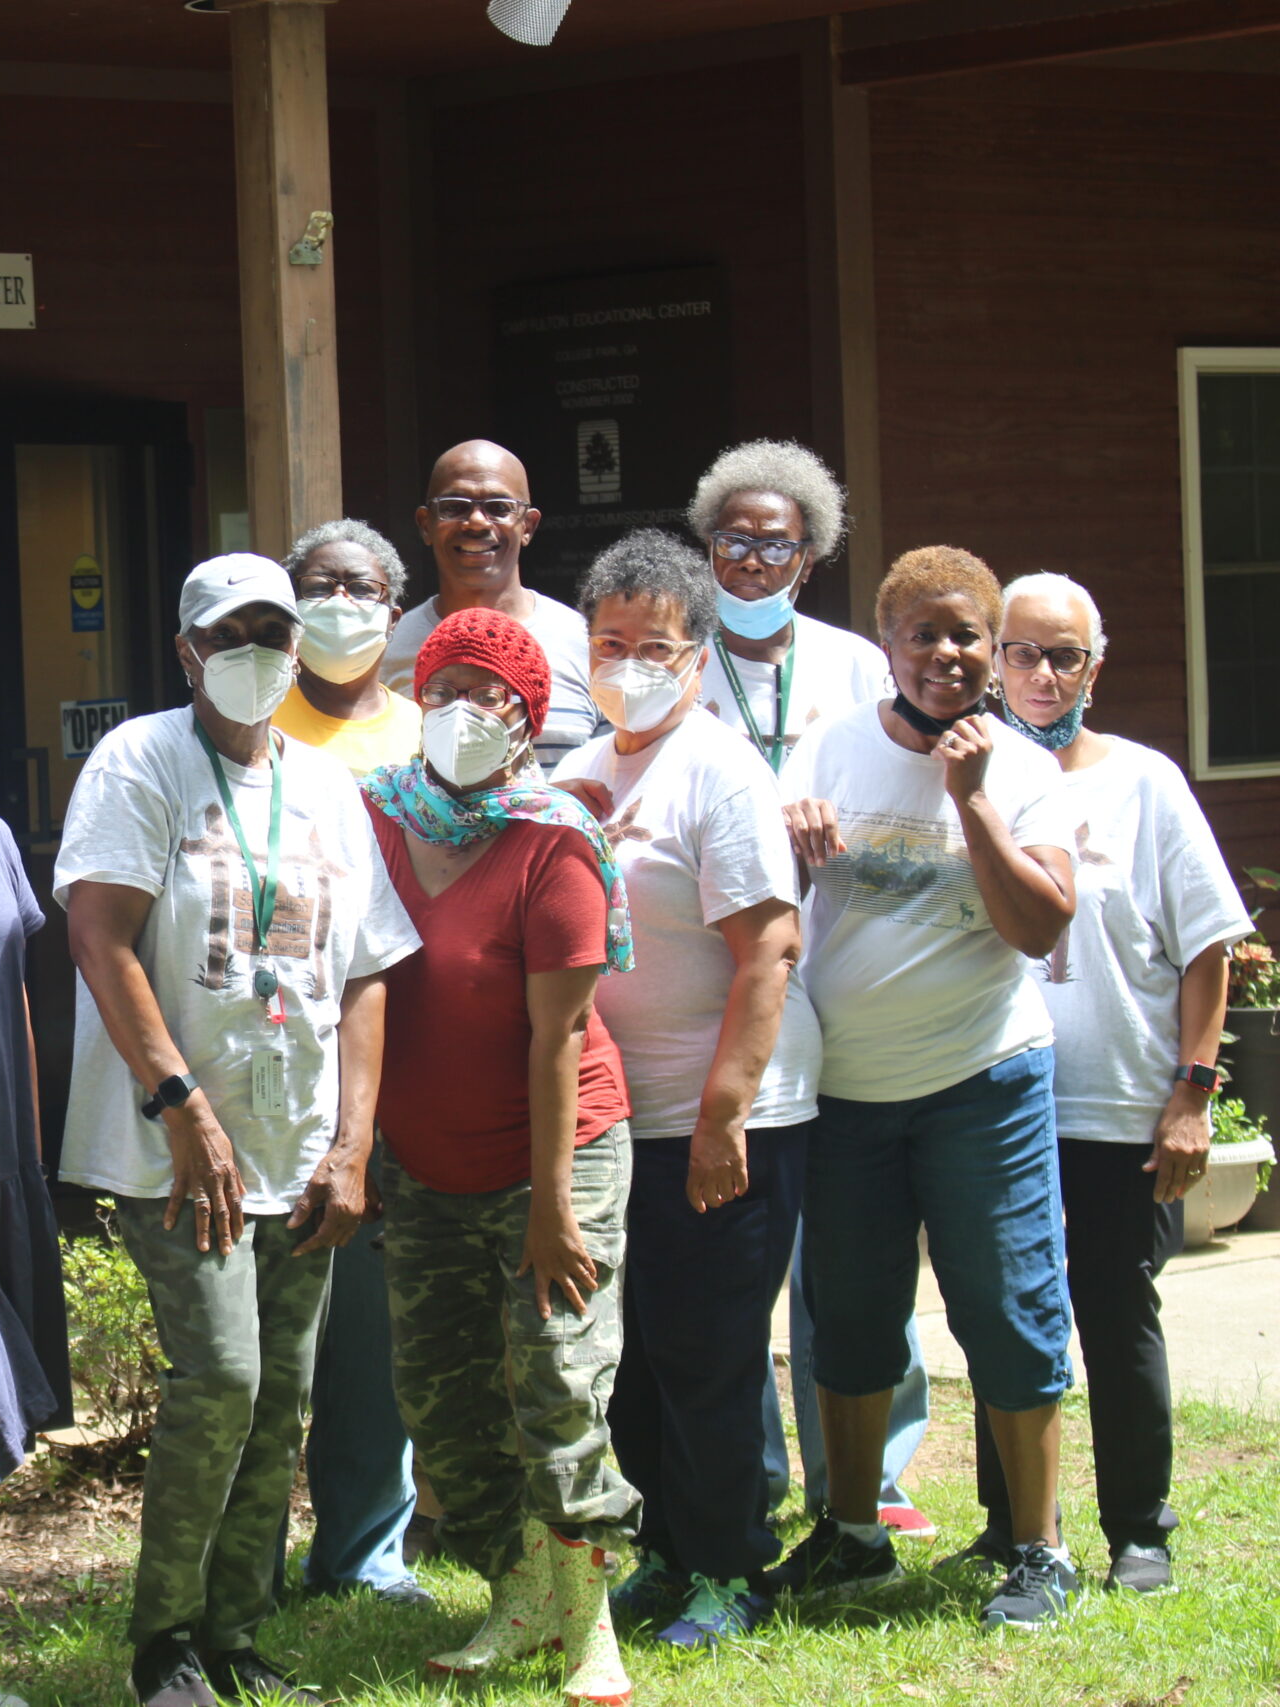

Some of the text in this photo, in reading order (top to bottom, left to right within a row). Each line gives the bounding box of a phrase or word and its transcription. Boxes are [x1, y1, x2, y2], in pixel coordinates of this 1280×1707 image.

[573, 305, 656, 327] EDUCATIONAL
[658, 300, 712, 319] CENTER
[555, 373, 640, 396] CONSTRUCTED
[567, 513, 583, 528] OF
